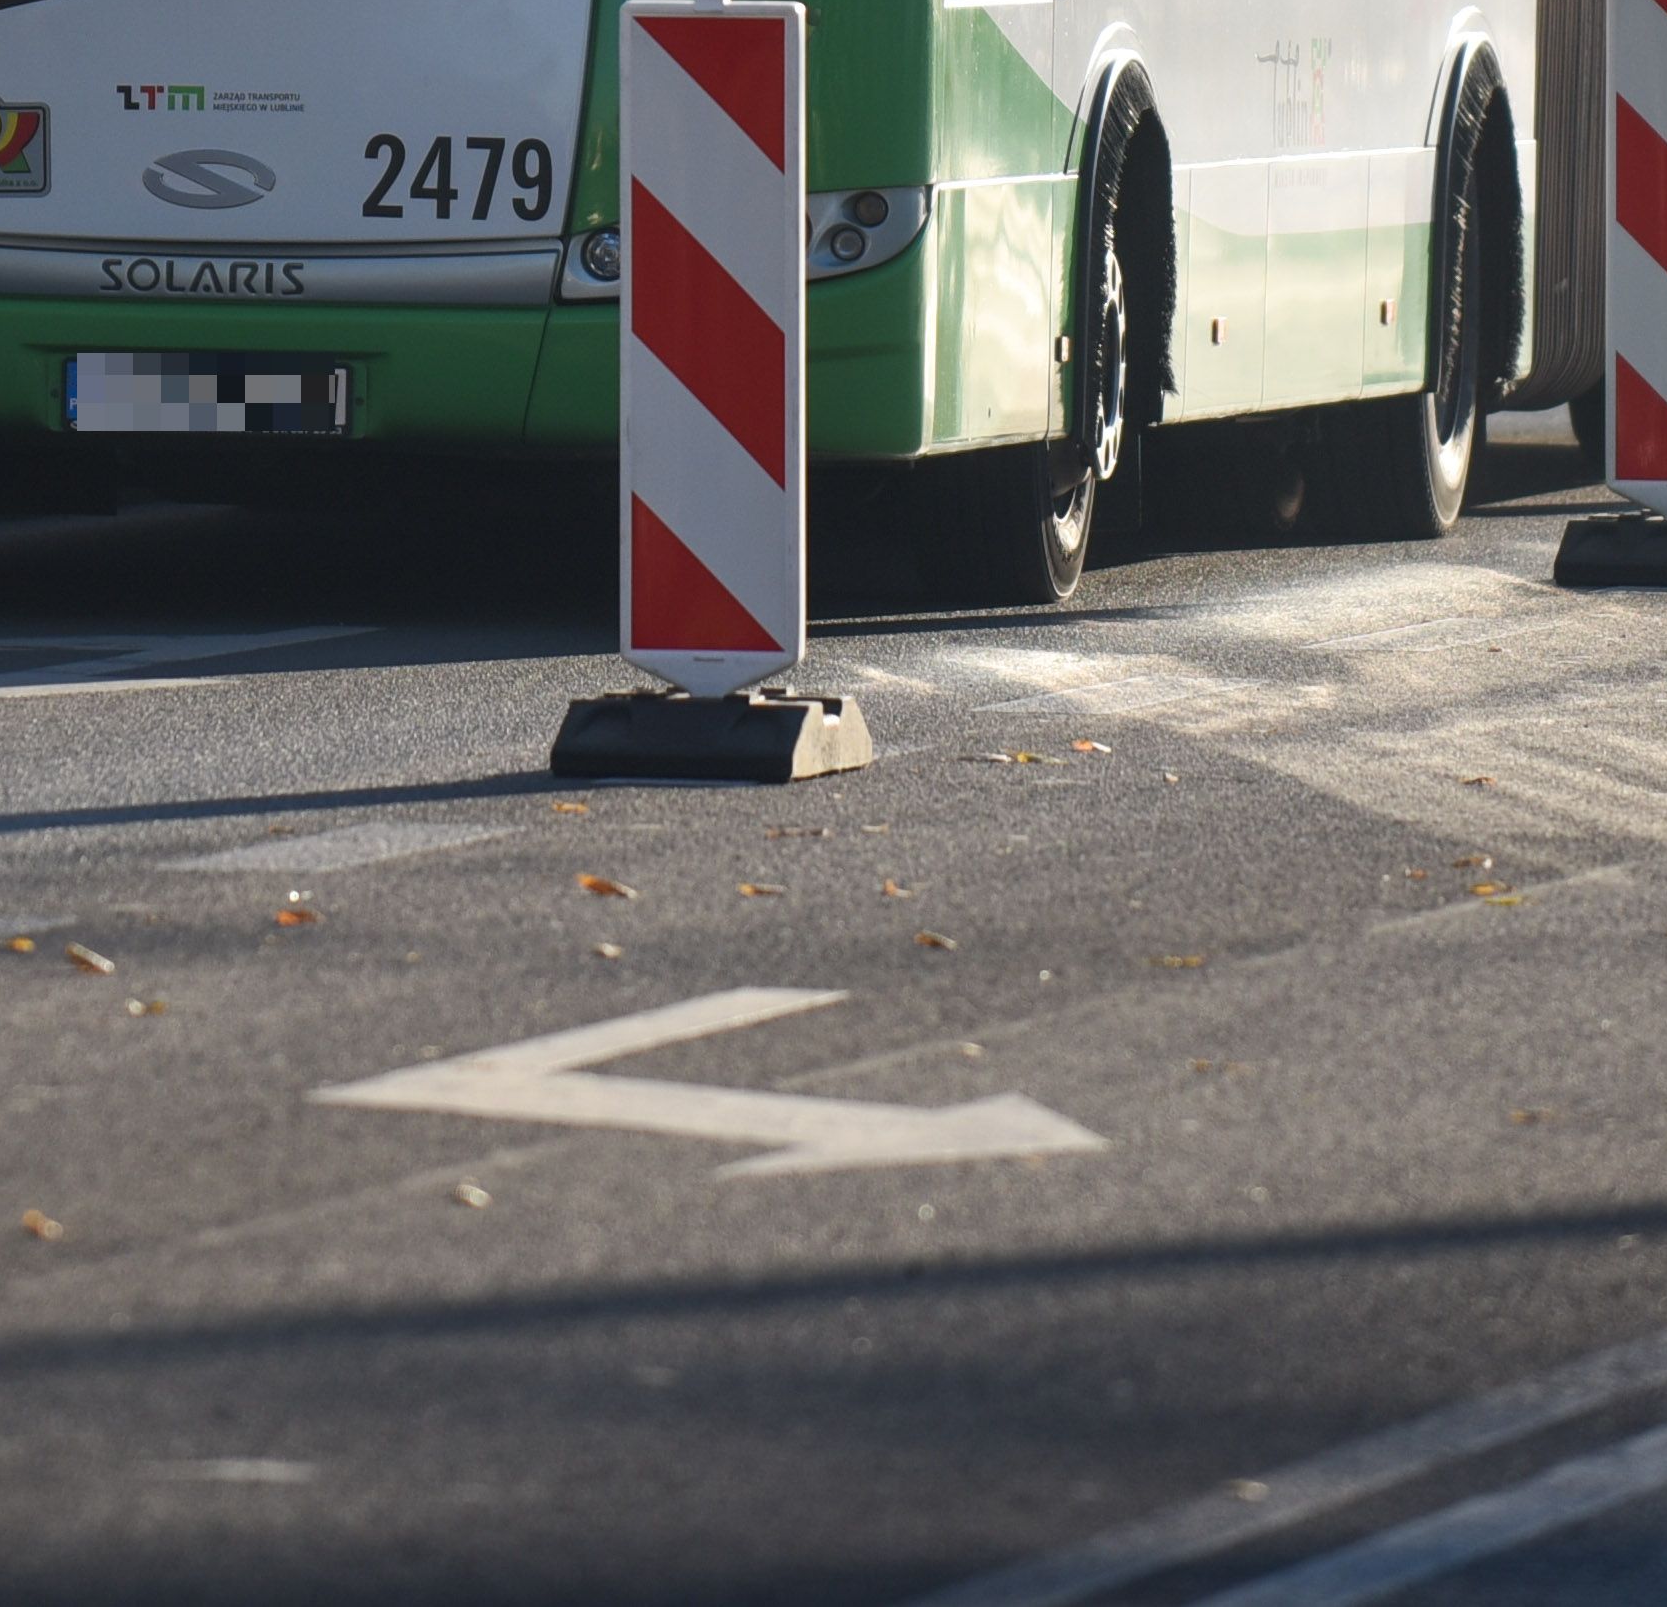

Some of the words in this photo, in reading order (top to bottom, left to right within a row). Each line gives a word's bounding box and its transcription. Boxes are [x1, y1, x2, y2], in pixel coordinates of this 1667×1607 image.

[212, 92, 246, 103] ZARZĄD
[247, 92, 301, 102] TRANSPORTU
[212, 103, 257, 113] MIEJSKIEGO
[259, 103, 268, 112] W
[270, 103, 305, 113] LUBLINIE
[361, 132, 553, 222] 2479
[98, 257, 306, 296] SOLARIS
